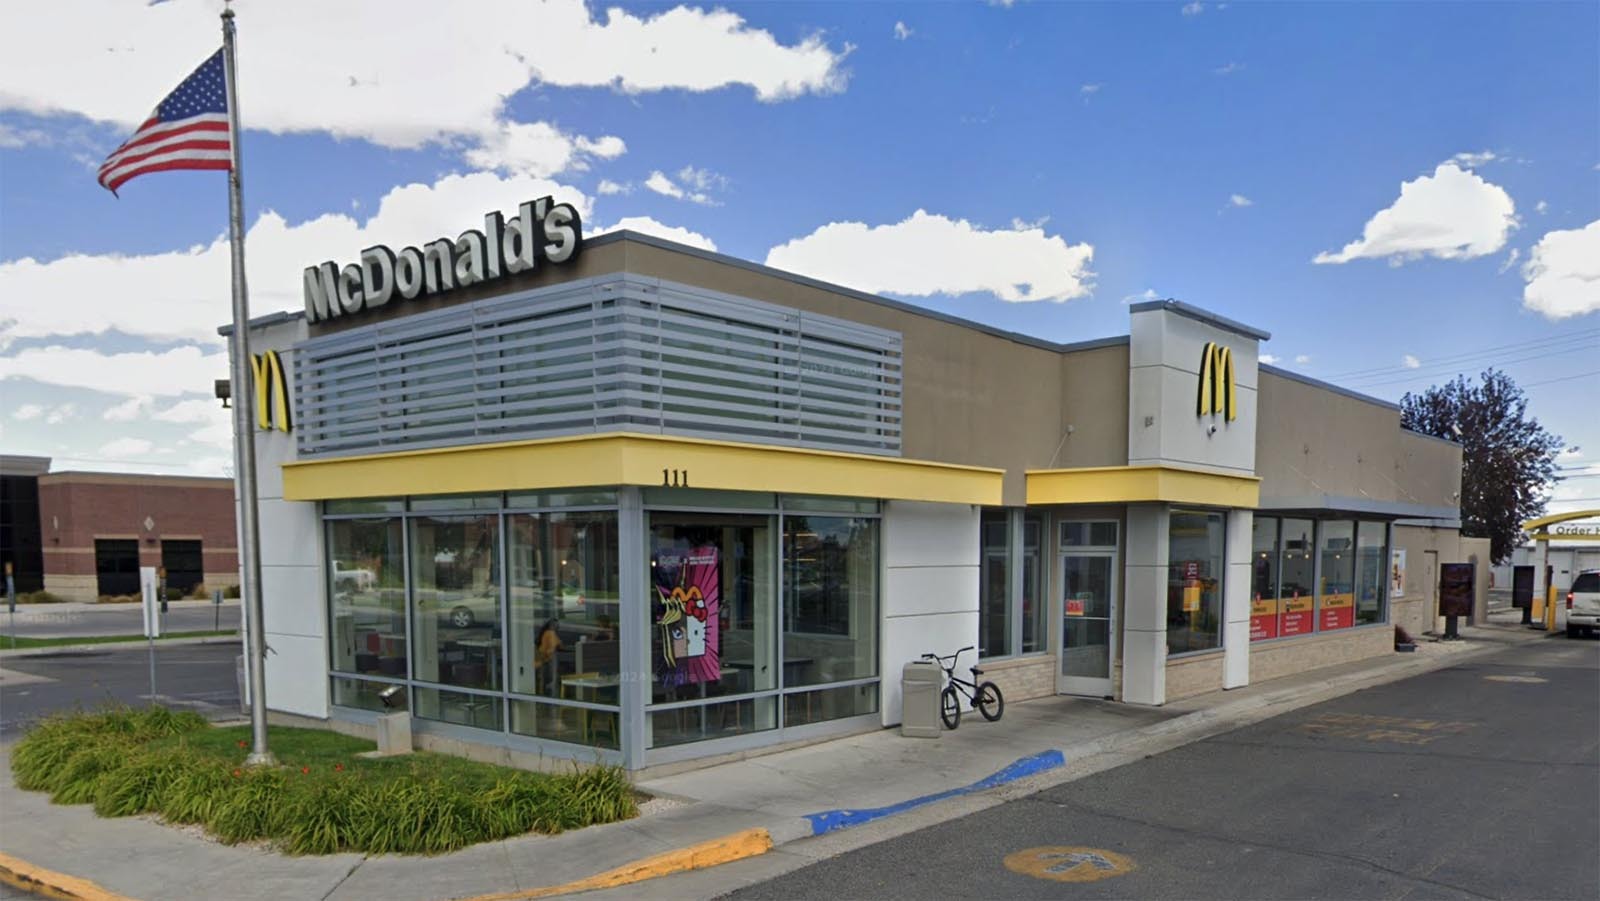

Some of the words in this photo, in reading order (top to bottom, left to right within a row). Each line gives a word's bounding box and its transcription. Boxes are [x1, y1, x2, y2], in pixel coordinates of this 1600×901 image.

[303, 196, 581, 324] McDonald's
[662, 469, 689, 488] 111
[1556, 526, 1593, 536] Order
